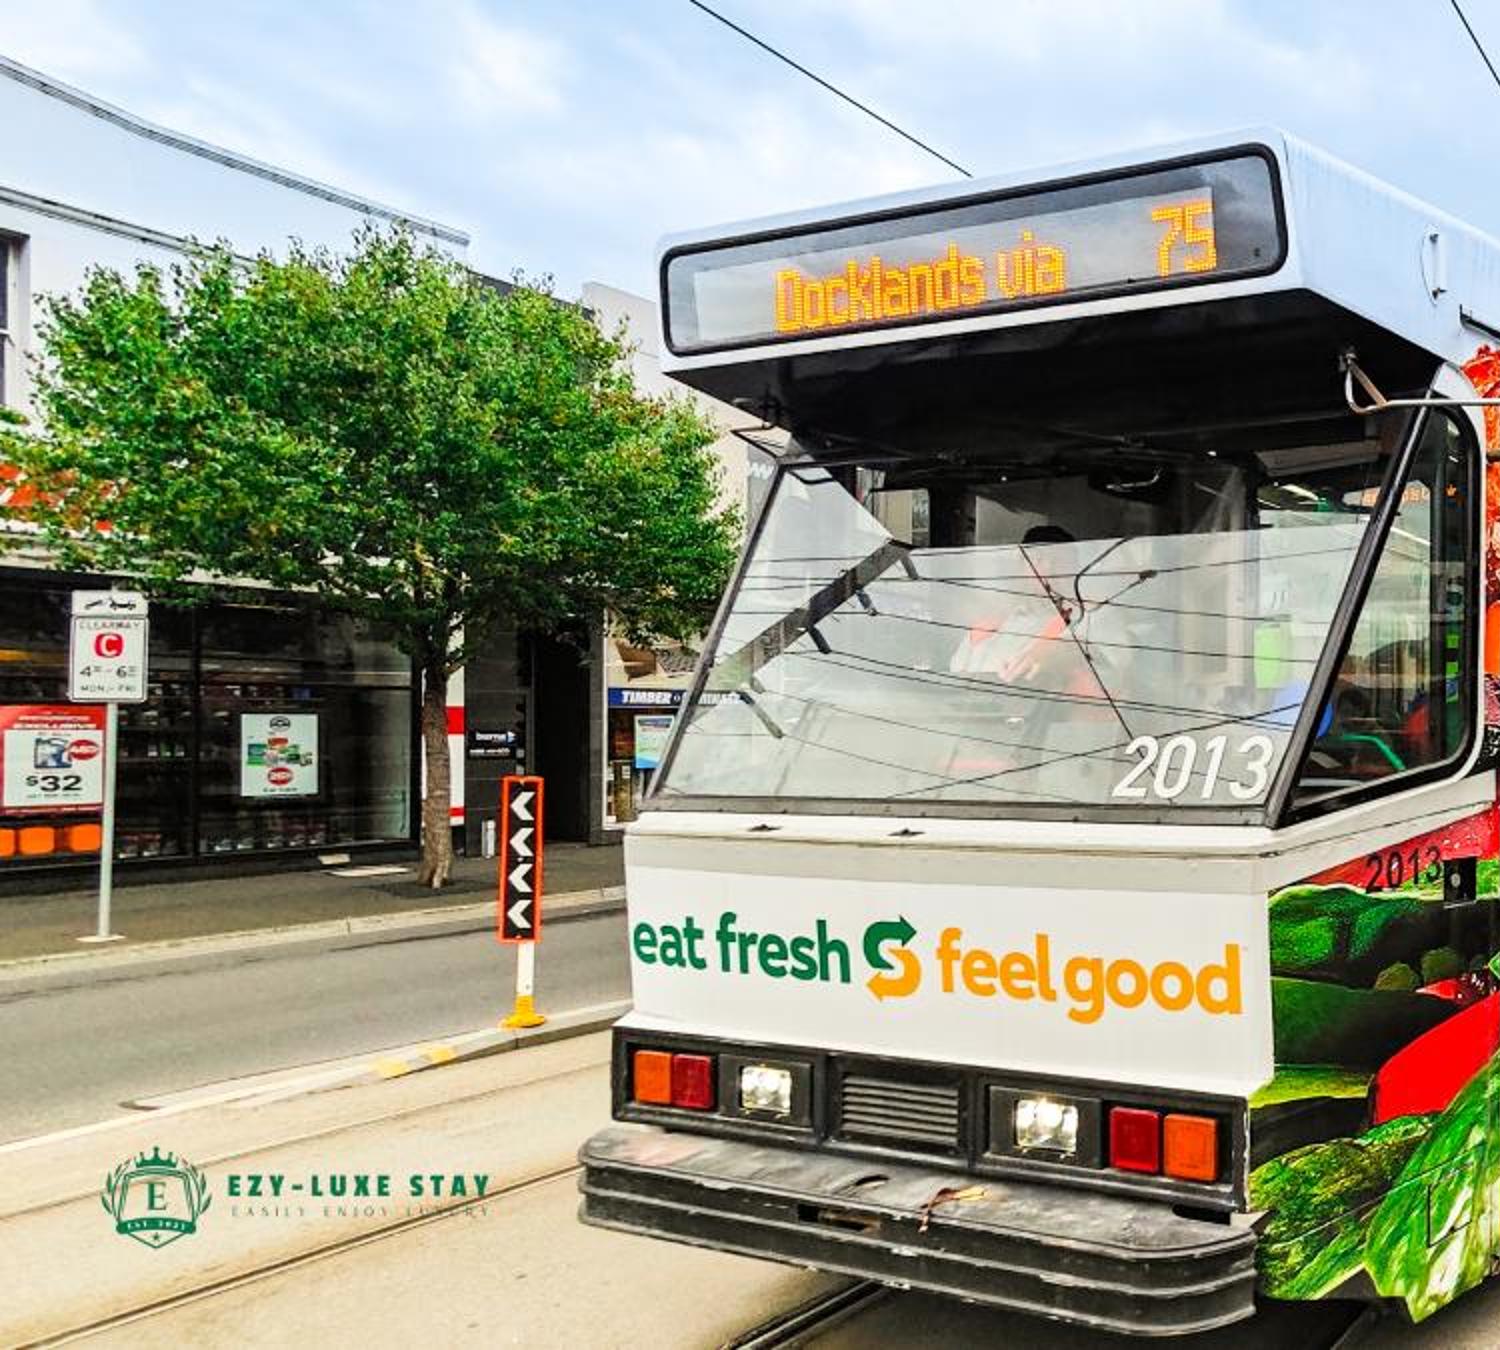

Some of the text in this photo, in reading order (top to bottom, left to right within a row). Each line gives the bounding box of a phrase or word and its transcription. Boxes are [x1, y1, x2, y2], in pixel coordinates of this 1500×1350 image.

[774, 197, 1219, 335] Docklands via 75
[80, 620, 140, 631] CLEARWAY
[622, 690, 672, 705] TIMBER
[26, 774, 83, 792] $32
[1111, 734, 1275, 801] 2013
[1365, 845, 1441, 894] 2013
[632, 914, 706, 971] eat
[716, 910, 852, 984] fresh
[935, 927, 1056, 1001] feel
[1065, 943, 1244, 1025] good
